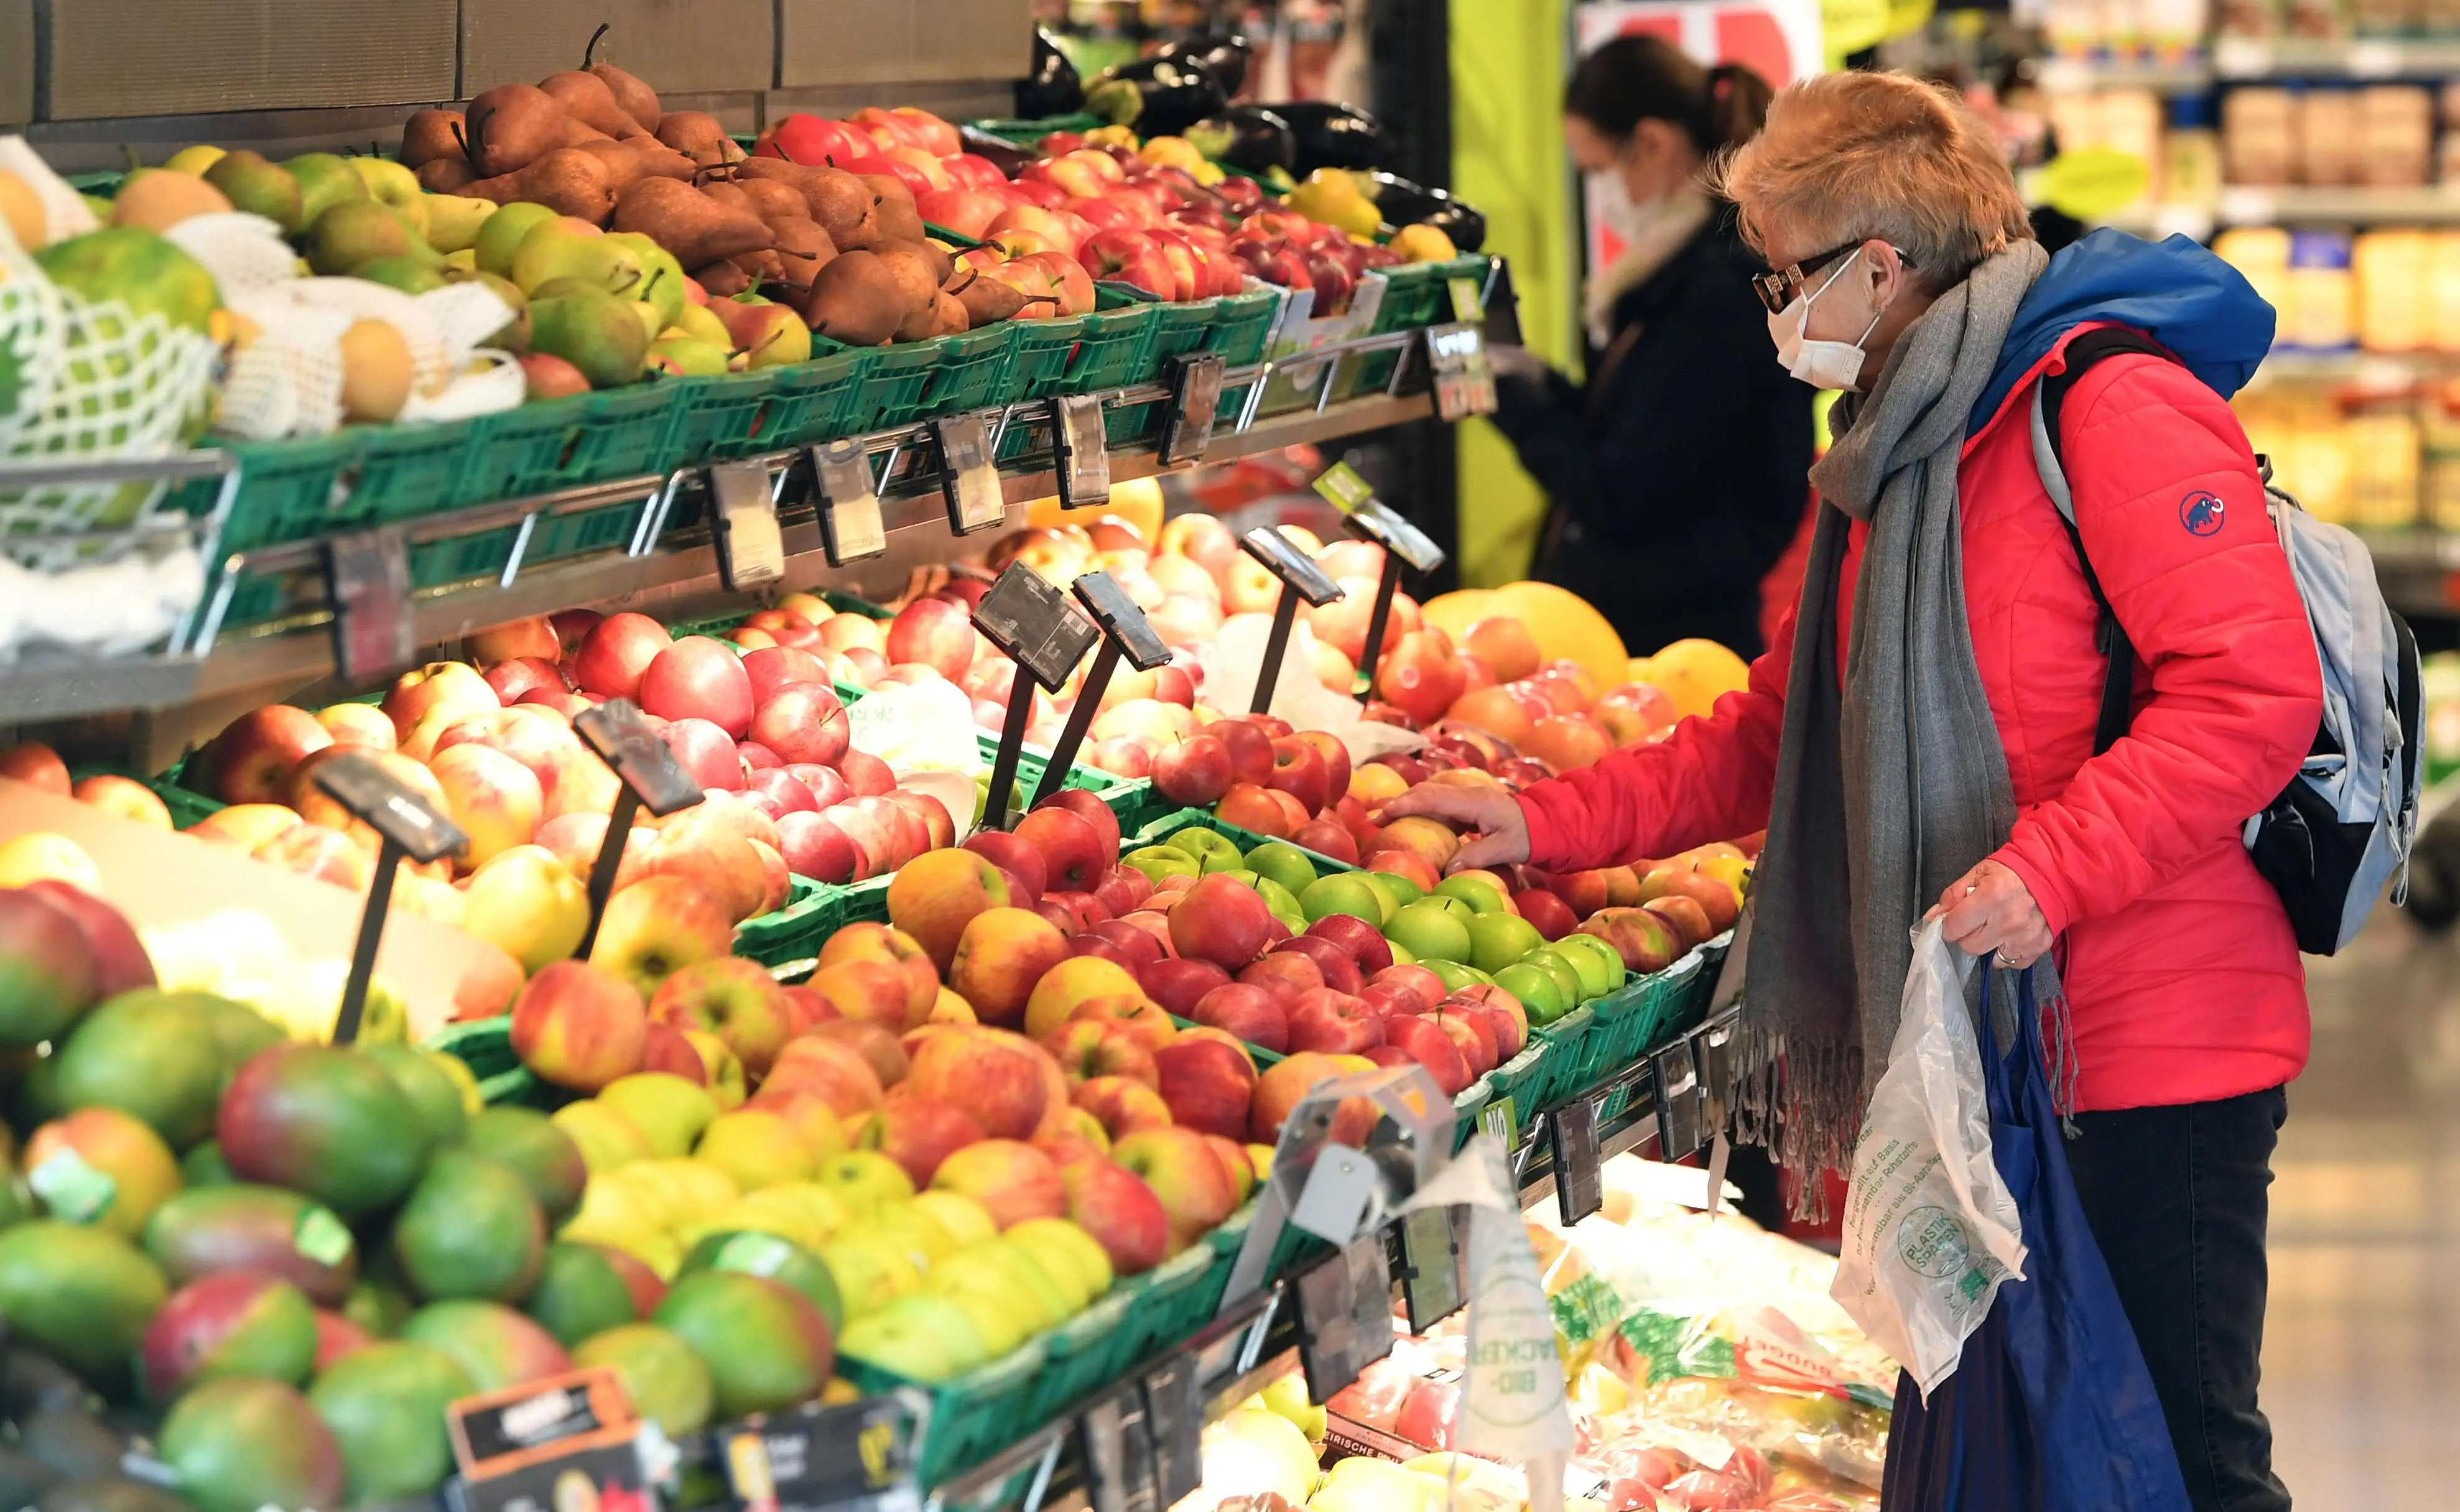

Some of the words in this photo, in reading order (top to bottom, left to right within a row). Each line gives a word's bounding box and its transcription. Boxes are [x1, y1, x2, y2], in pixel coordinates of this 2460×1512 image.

[1485, 1106, 1508, 1149] BIO
[1867, 1158, 1880, 1175] auf
[1877, 1139, 1900, 1162] Basis
[1892, 1193, 1907, 1209] als
[1906, 1212, 1952, 1260] PLASTIK
[1916, 1223, 1960, 1269] SPAREN
